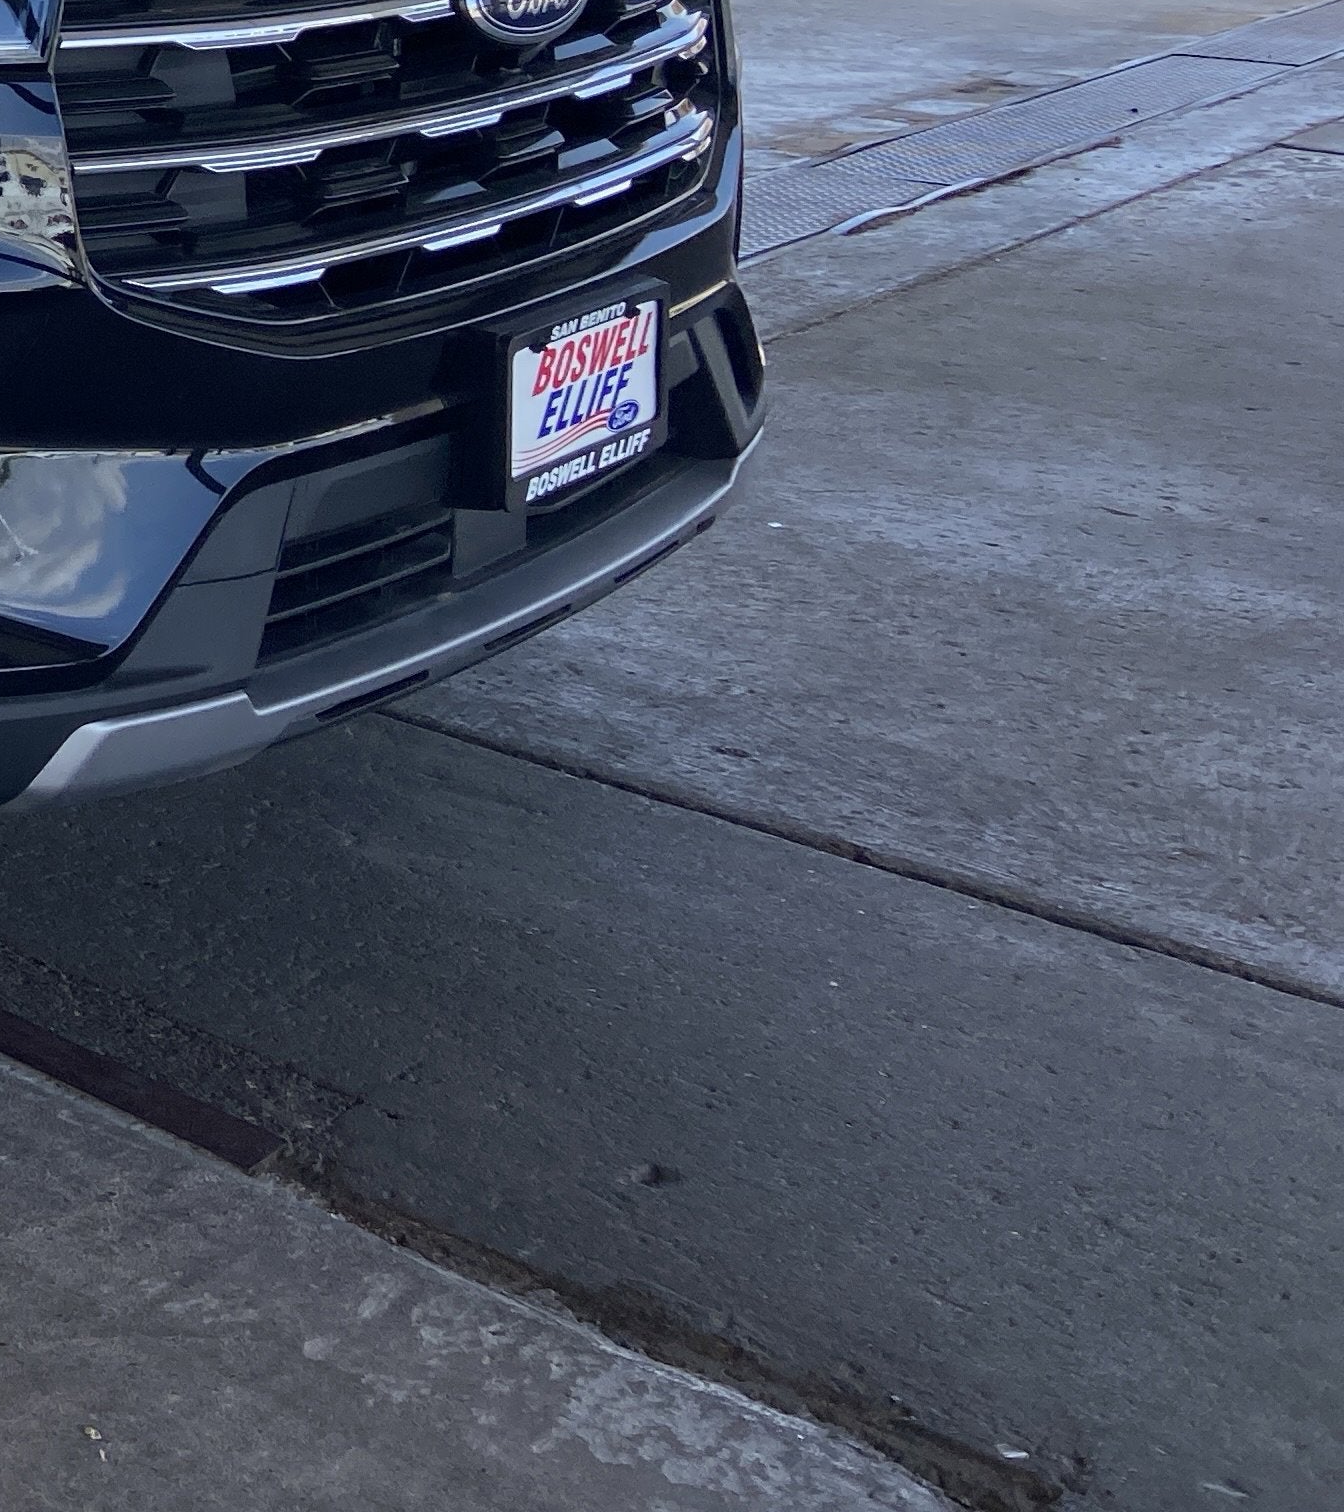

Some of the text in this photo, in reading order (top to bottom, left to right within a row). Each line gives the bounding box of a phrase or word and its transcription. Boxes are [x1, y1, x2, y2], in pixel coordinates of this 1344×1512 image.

[531, 311, 654, 396] BOSWELL
[550, 301, 627, 341] SAN BENITO
[537, 361, 634, 439] ELLIFF
[525, 428, 652, 503] BOSWELL ELLIFF
